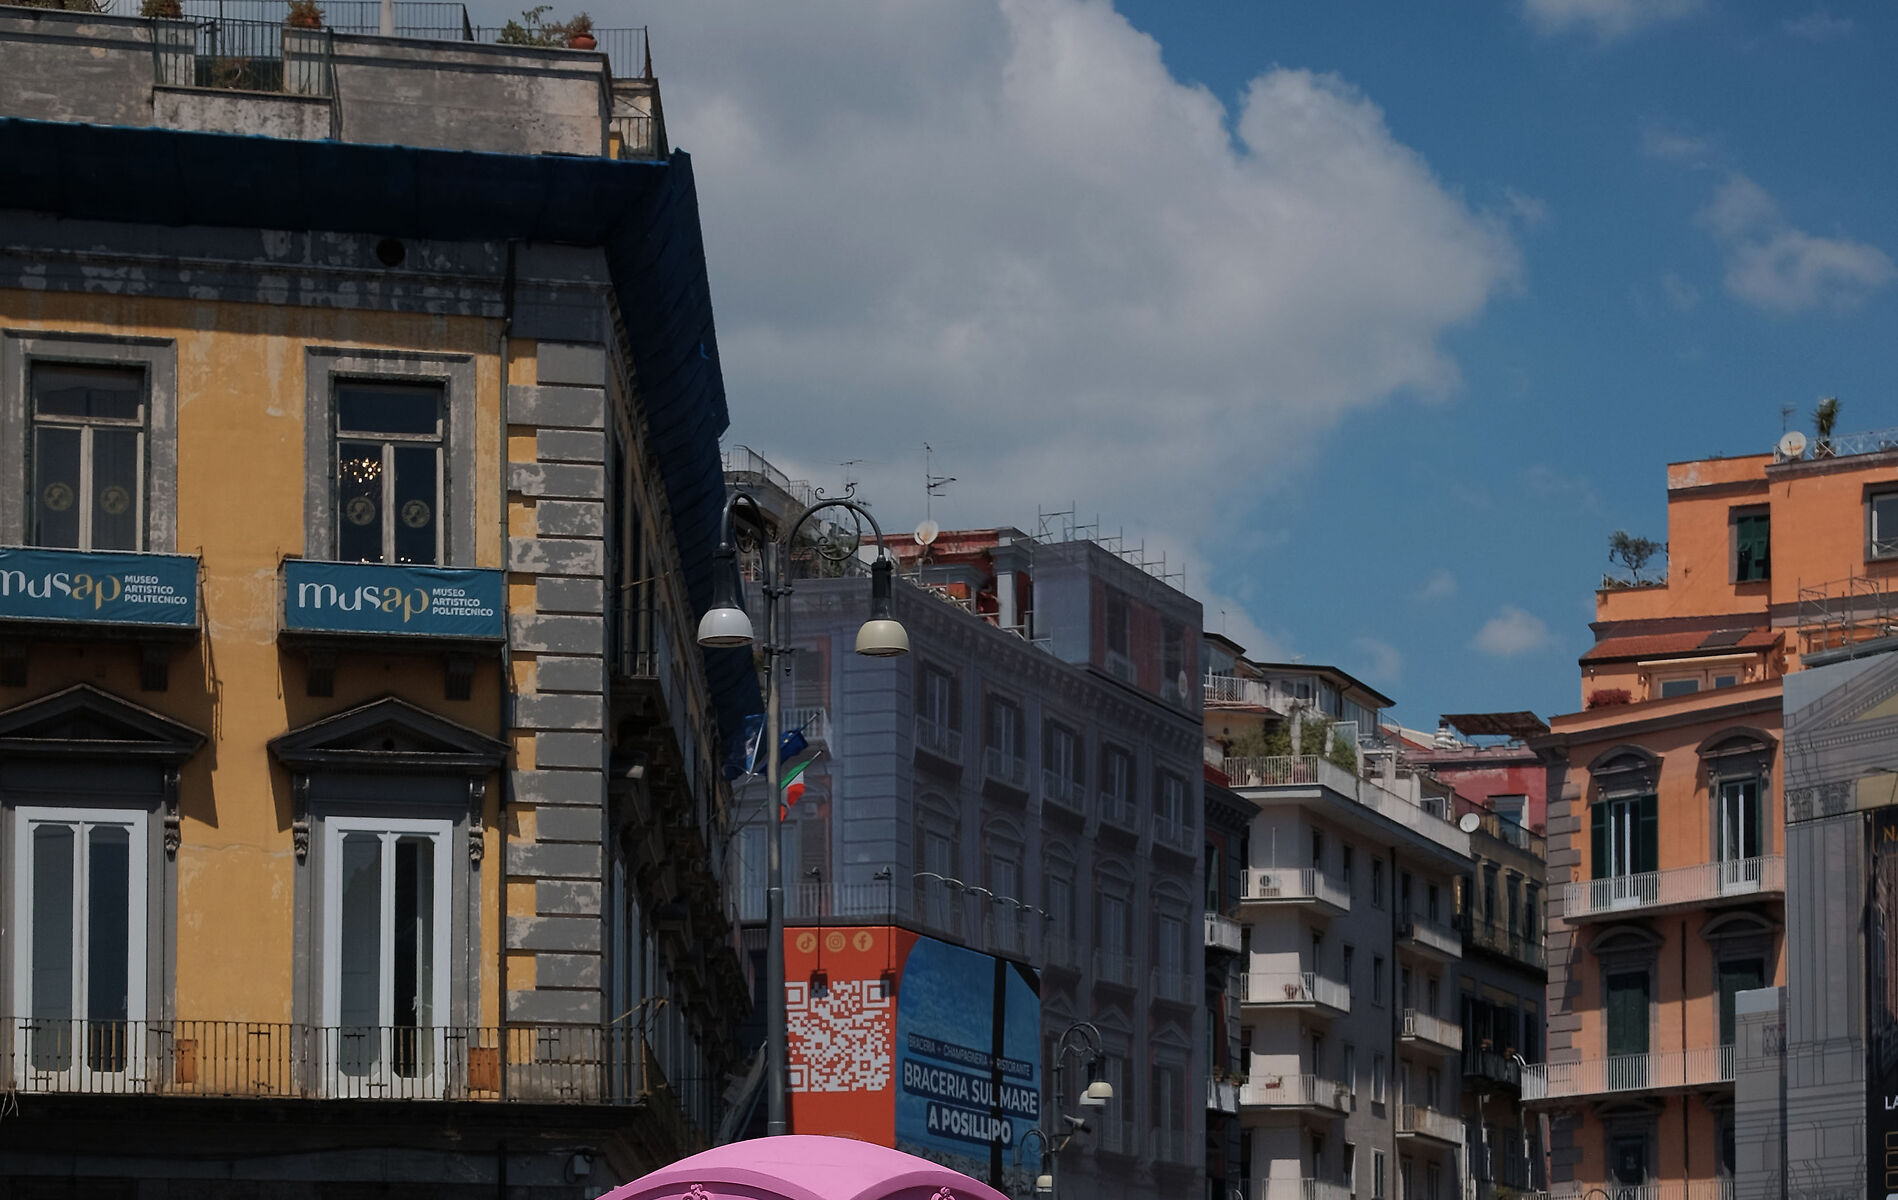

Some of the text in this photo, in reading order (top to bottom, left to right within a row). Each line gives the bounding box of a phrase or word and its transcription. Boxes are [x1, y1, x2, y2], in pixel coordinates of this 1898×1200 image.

[124, 574, 159, 585] MUSEO
[124, 584, 174, 595] ARTISTICO
[432, 588, 466, 598] MUSEO
[124, 593, 188, 605] POLITECNICO
[299, 583, 429, 623] musap
[432, 597, 481, 607] ARTISTICO
[432, 606, 494, 617] POLITECNICO
[908, 1035, 936, 1053] BRACERIA
[904, 1062, 1038, 1114] BRACERIA SUL MARE
[928, 1105, 1011, 1144] A POSILLIPO
